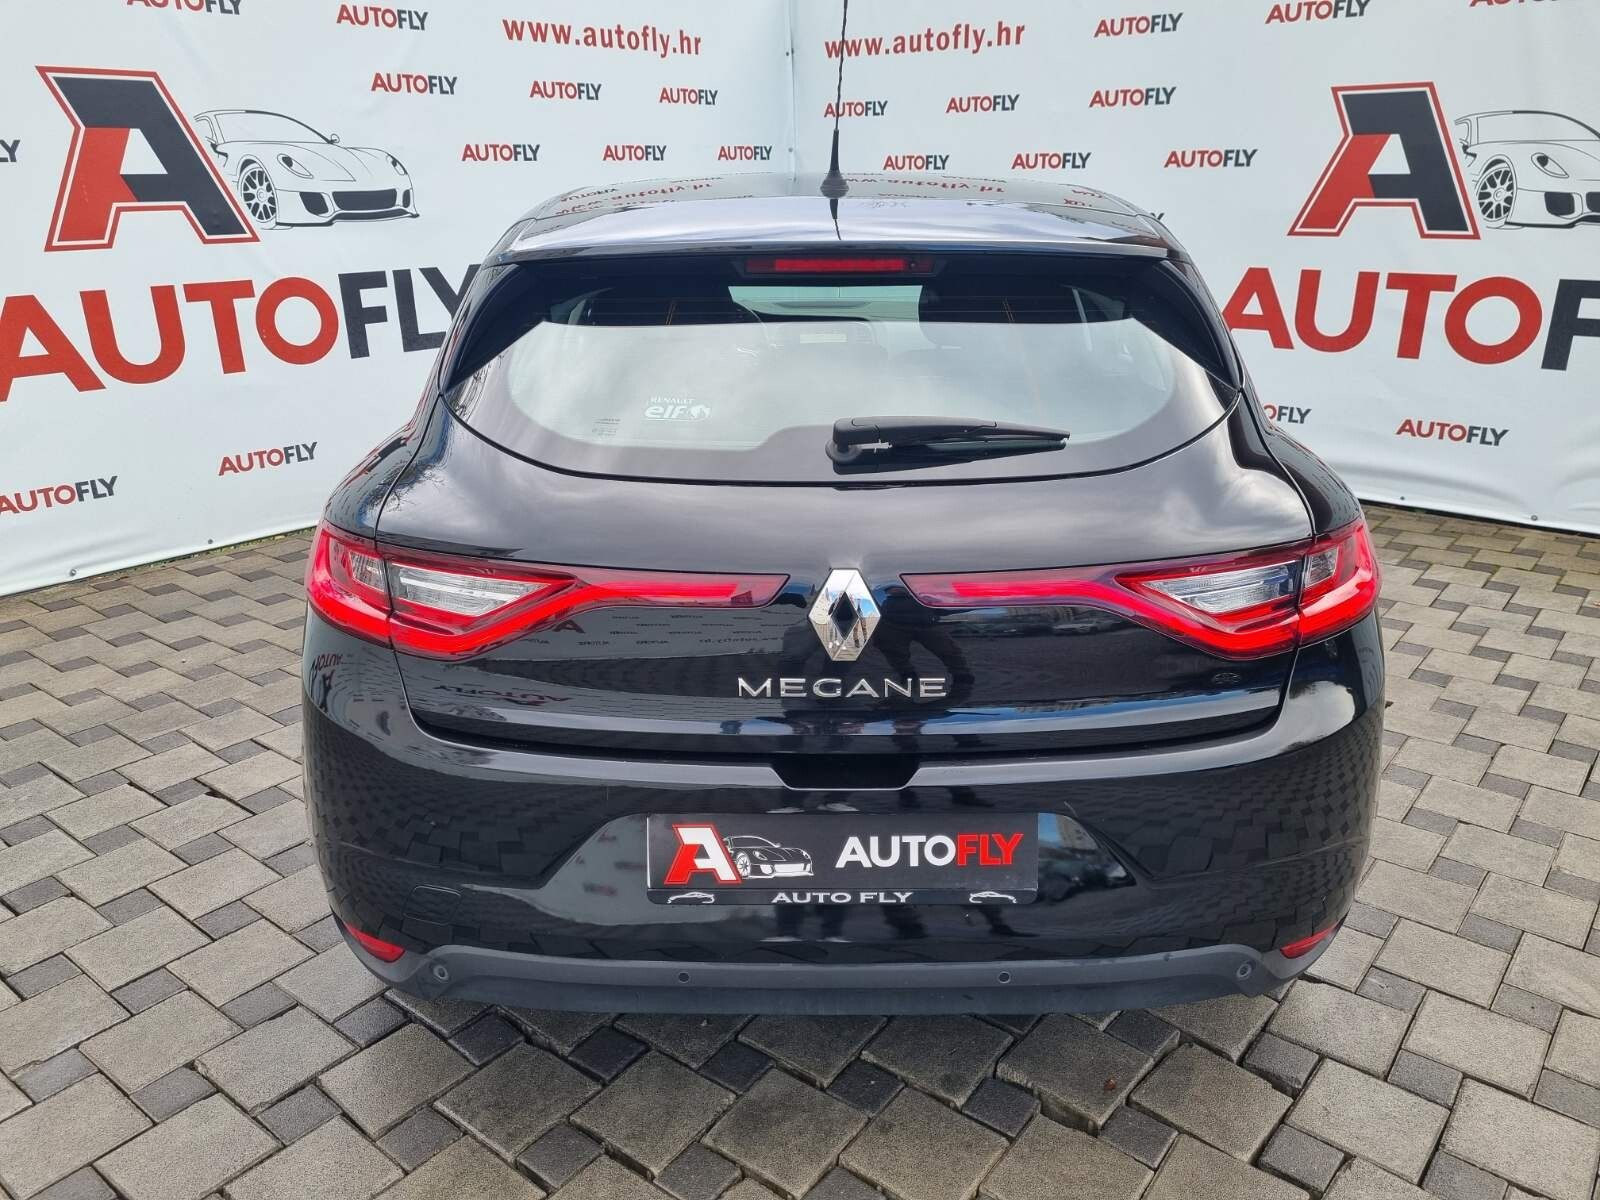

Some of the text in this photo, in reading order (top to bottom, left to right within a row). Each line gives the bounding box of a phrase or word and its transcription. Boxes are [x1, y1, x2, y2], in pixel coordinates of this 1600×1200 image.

[336, 4, 428, 30] AUTOFLY
[1265, 0, 1370, 24] AUTOFLY
[1094, 13, 1183, 37] AUTOFLY
[503, 19, 701, 58] www.autofly.hr
[825, 22, 1025, 58] www.autofly.hr
[371, 73, 457, 95] AUTOFLY
[530, 81, 601, 100] AUTOFLY
[660, 88, 718, 105] AUTOFLY
[946, 94, 1019, 113] AUTOFLY
[1089, 87, 1176, 107] AUTOFLY
[825, 101, 888, 118] AUTOFLY
[462, 144, 540, 161] AUTOFLY
[603, 145, 667, 161] AUTOFLY
[718, 145, 772, 161] AUTOFLY
[1012, 152, 1091, 169] AUTOFLY
[1164, 149, 1257, 168] AUTOFLY
[884, 155, 949, 170] AUTOFLY
[1396, 419, 1509, 446] AUTOFLY
[219, 442, 317, 475] AUTOFLY
[0, 476, 117, 513] AUTOFLY
[738, 678, 946, 697] MEGANE
[835, 833, 1024, 868] AUTOFLY
[772, 892, 913, 903] AUTO FLY
